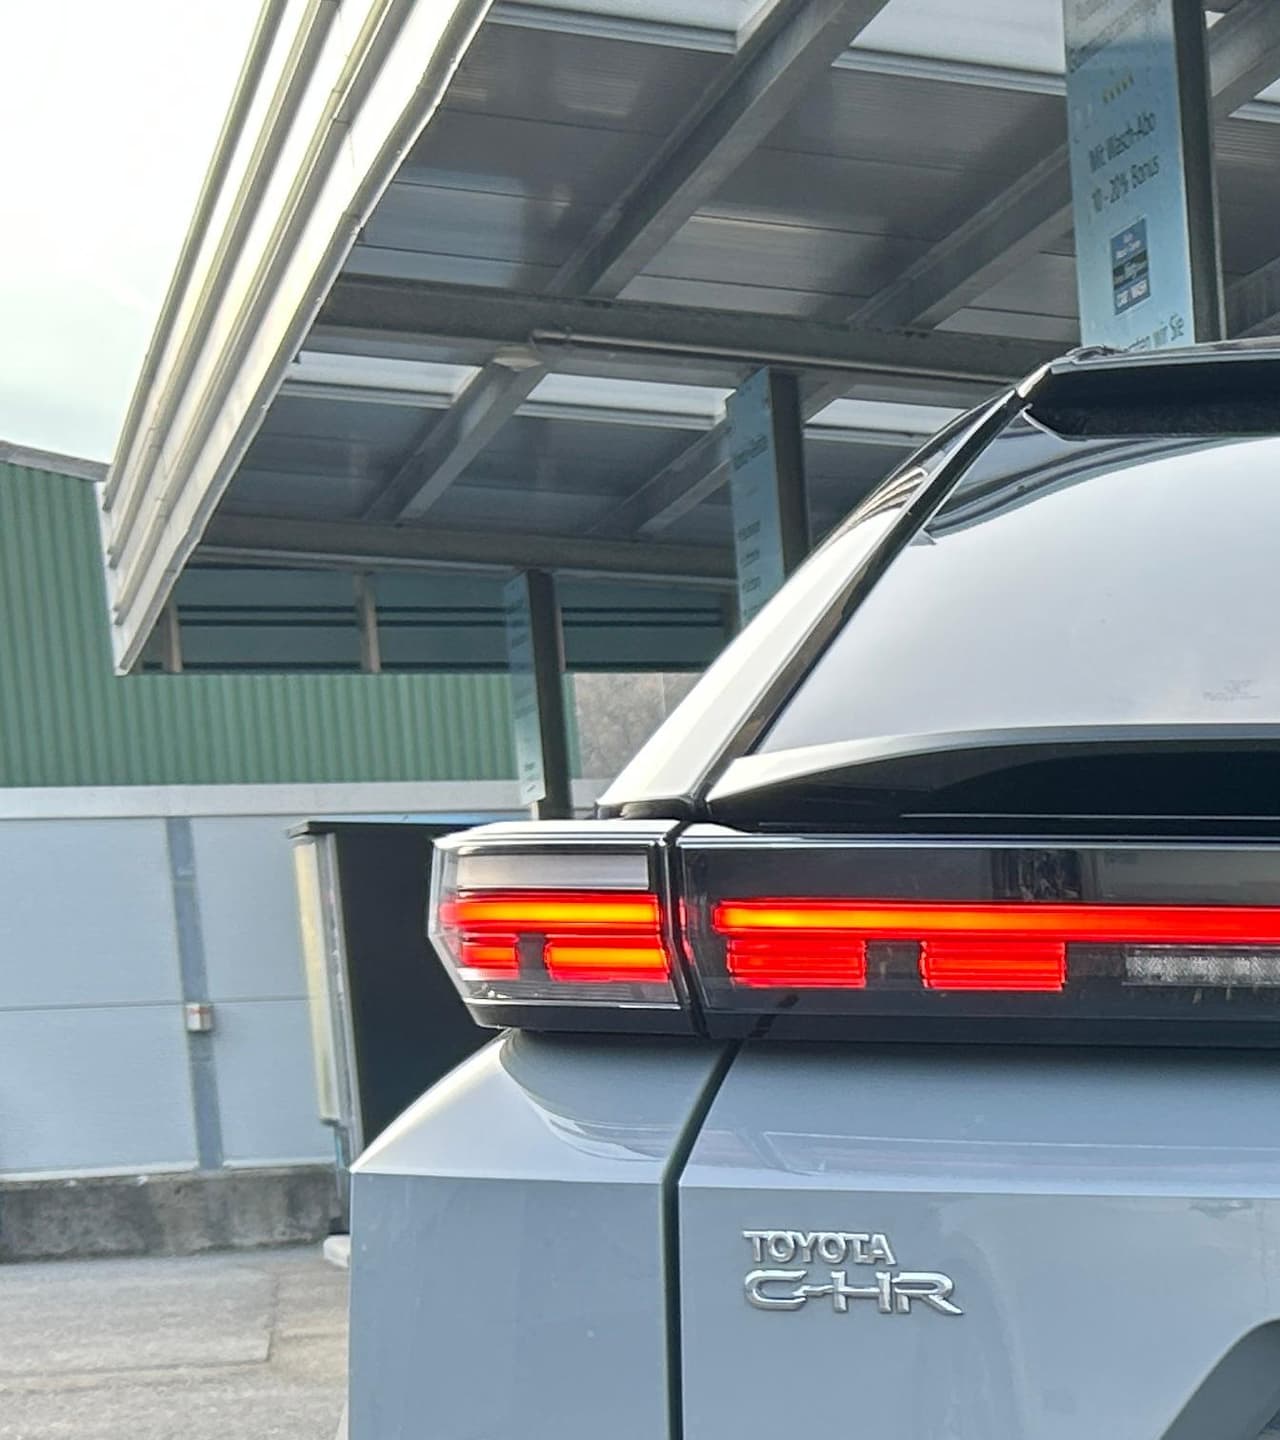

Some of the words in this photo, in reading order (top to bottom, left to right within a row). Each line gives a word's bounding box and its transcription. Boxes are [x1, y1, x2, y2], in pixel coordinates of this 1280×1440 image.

[1131, 154, 1160, 190] Bonus
[743, 1230, 896, 1265] TOYOTA
[744, 1269, 964, 1315] C-HR
